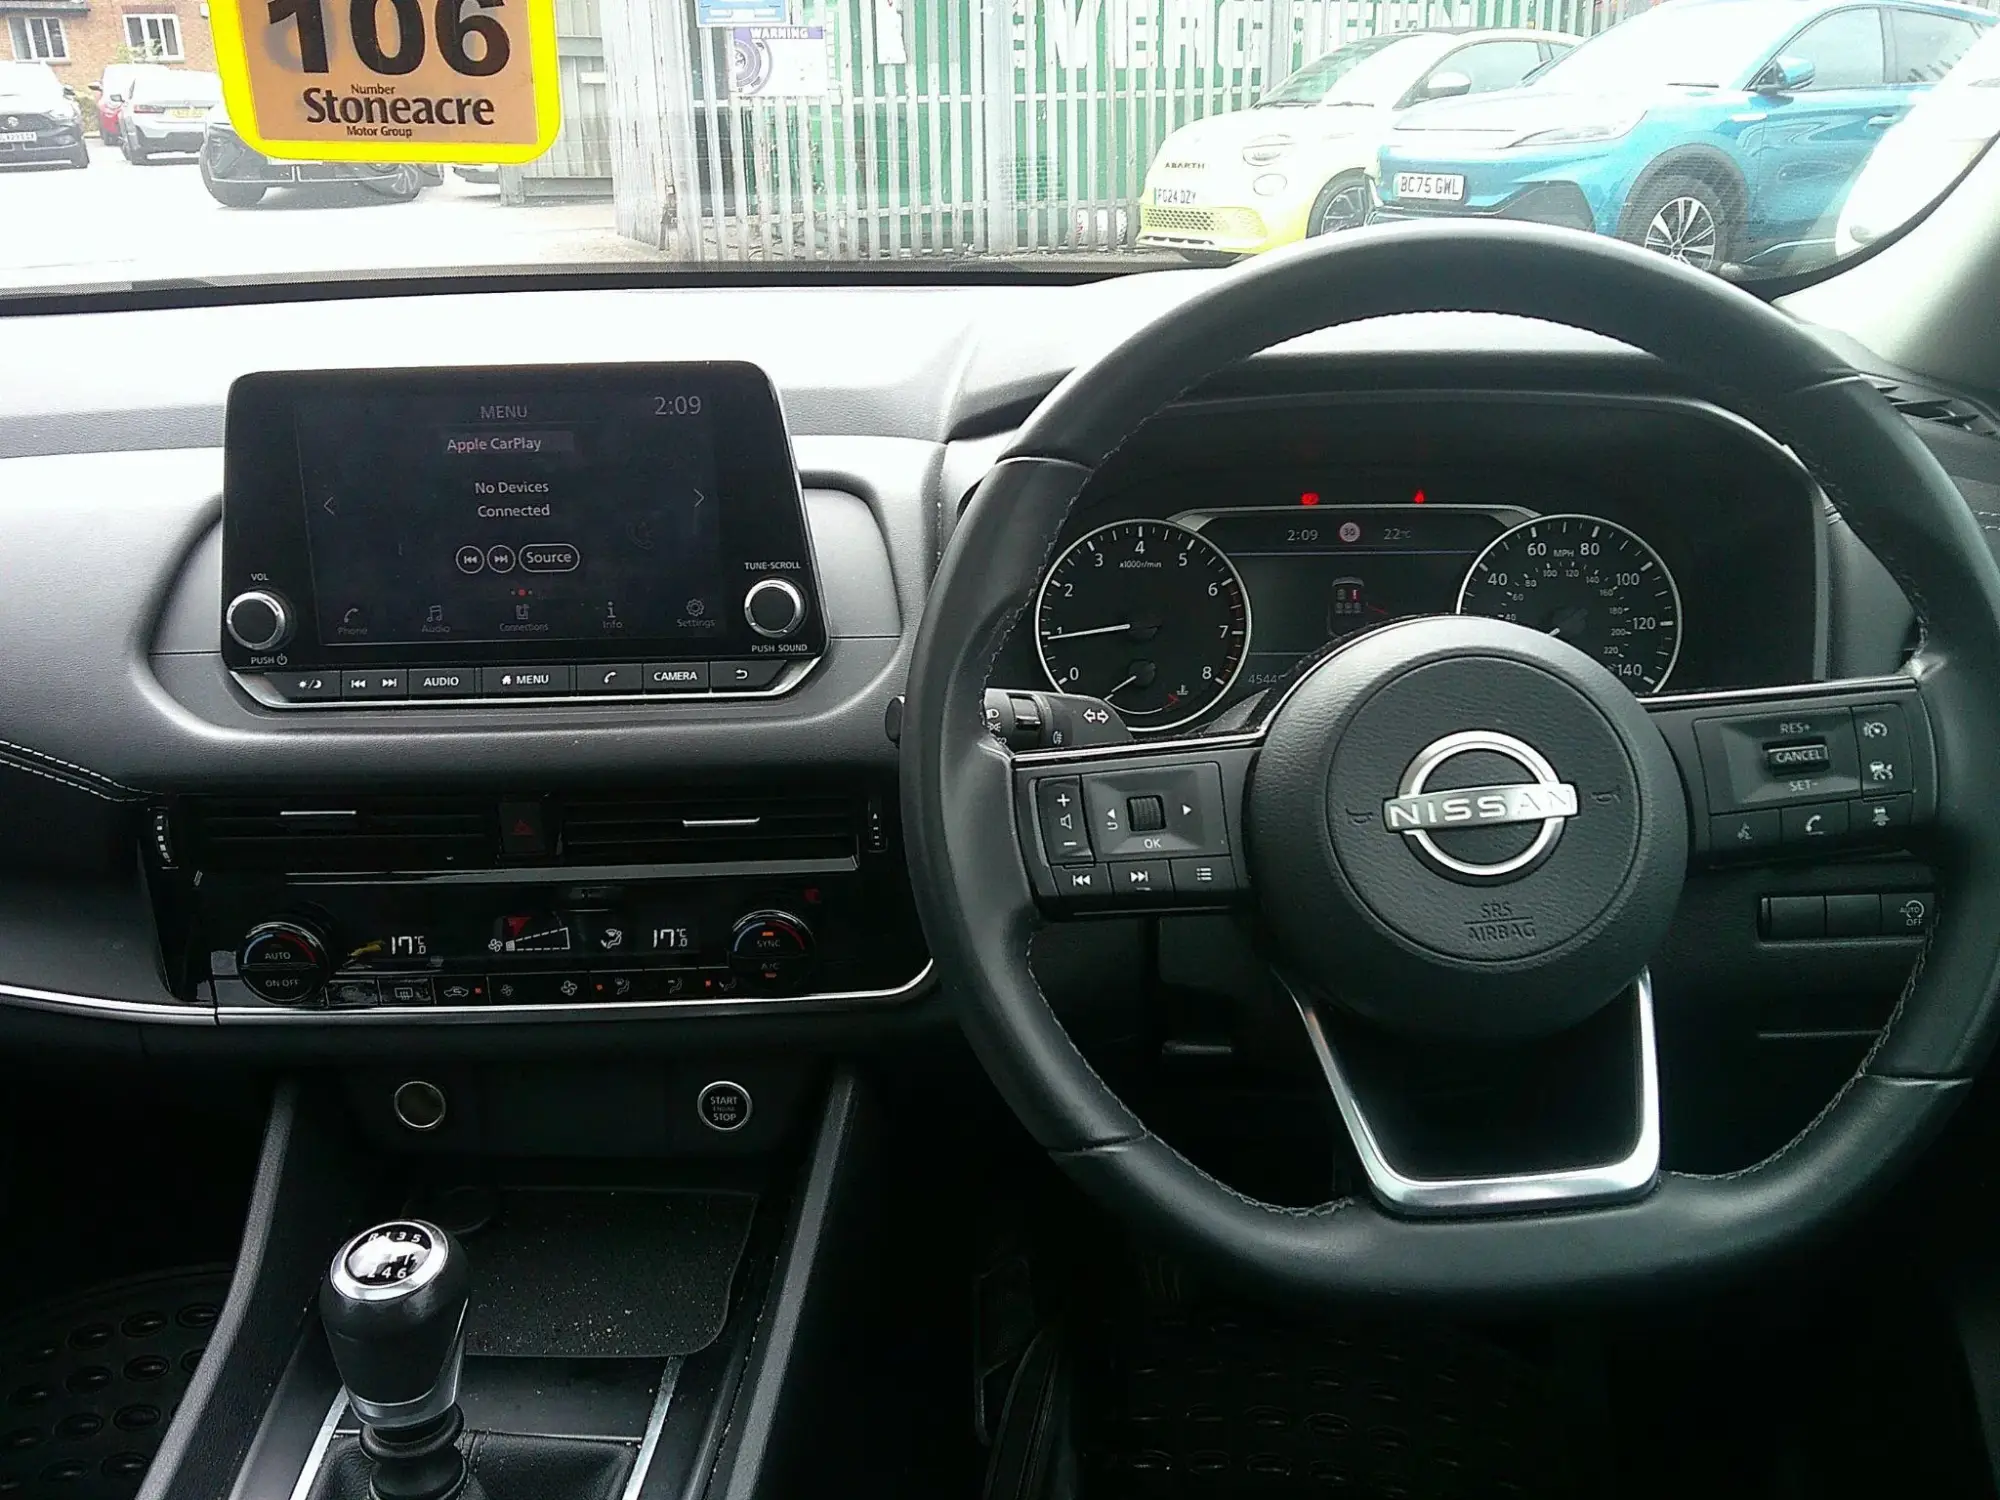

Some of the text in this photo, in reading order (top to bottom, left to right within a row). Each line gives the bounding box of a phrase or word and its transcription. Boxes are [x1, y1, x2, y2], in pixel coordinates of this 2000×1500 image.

[267, 0, 511, 77] 106
[751, 28, 809, 39] WARNING
[351, 84, 396, 96] Number
[303, 87, 495, 125] Stoneacre
[347, 126, 412, 138] Motor Group
[1164, 161, 1206, 169] ABARTH
[1400, 176, 1459, 195] BC75 GWL
[480, 405, 527, 418] MENU
[654, 395, 702, 416] 2:09
[447, 437, 541, 453] Apple CarPlay
[474, 482, 549, 494] No Devices
[477, 504, 550, 518] Connected
[1287, 529, 1318, 541] 2:09
[1134, 541, 1145, 554] 4
[1527, 543, 1547, 556] 60
[1553, 549, 1575, 557] MPH
[1580, 543, 1600, 556] 80
[526, 551, 572, 564] Source
[1094, 553, 1104, 567] 3
[1178, 553, 1188, 566] 5
[1119, 560, 1162, 569] x1000r/min
[251, 573, 269, 581] VOL
[1543, 569, 1557, 577] 100
[1565, 569, 1580, 577] 120
[1487, 573, 1508, 586] 40
[1524, 579, 1537, 587] 80
[1585, 576, 1600, 584] 140
[1615, 573, 1640, 586] 100
[1064, 583, 1073, 597] 2
[1207, 582, 1219, 596] 6
[1600, 588, 1614, 597] 160
[1512, 593, 1524, 601] 60
[1609, 606, 1623, 614] 180
[1505, 613, 1517, 621] 40
[422, 625, 450, 633] Audio
[499, 621, 549, 632] Connections
[603, 619, 623, 629] Info
[676, 617, 716, 630] Settings
[1632, 617, 1656, 630] 120
[337, 626, 368, 635] Phone
[1218, 625, 1229, 639] 7
[1611, 628, 1625, 636] 200
[751, 642, 808, 652] PUSH SOUND
[1604, 646, 1618, 654] 220
[250, 656, 275, 665] PUSH
[1069, 667, 1080, 680] 0
[1202, 666, 1212, 680] 8
[1618, 664, 1643, 676] 140
[423, 677, 459, 687] AUDIO
[516, 673, 549, 684] MENU
[653, 671, 698, 682] CAMERA
[1775, 750, 1824, 763] CANCEL
[1387, 793, 1572, 826] NISSAN
[1144, 838, 1162, 849] OK
[1481, 902, 1513, 917] SRS
[1906, 918, 1923, 926] OFF
[1466, 923, 1536, 943] AIRBAG
[757, 939, 781, 948] SYNC
[264, 951, 291, 960] AUTO
[265, 979, 299, 988] ON OFF
[710, 1096, 738, 1105] START
[713, 1113, 737, 1121] STOP
[396, 1231, 406, 1241] 3
[411, 1233, 422, 1243] 5
[381, 1266, 393, 1279] 4
[397, 1267, 407, 1279] 6
